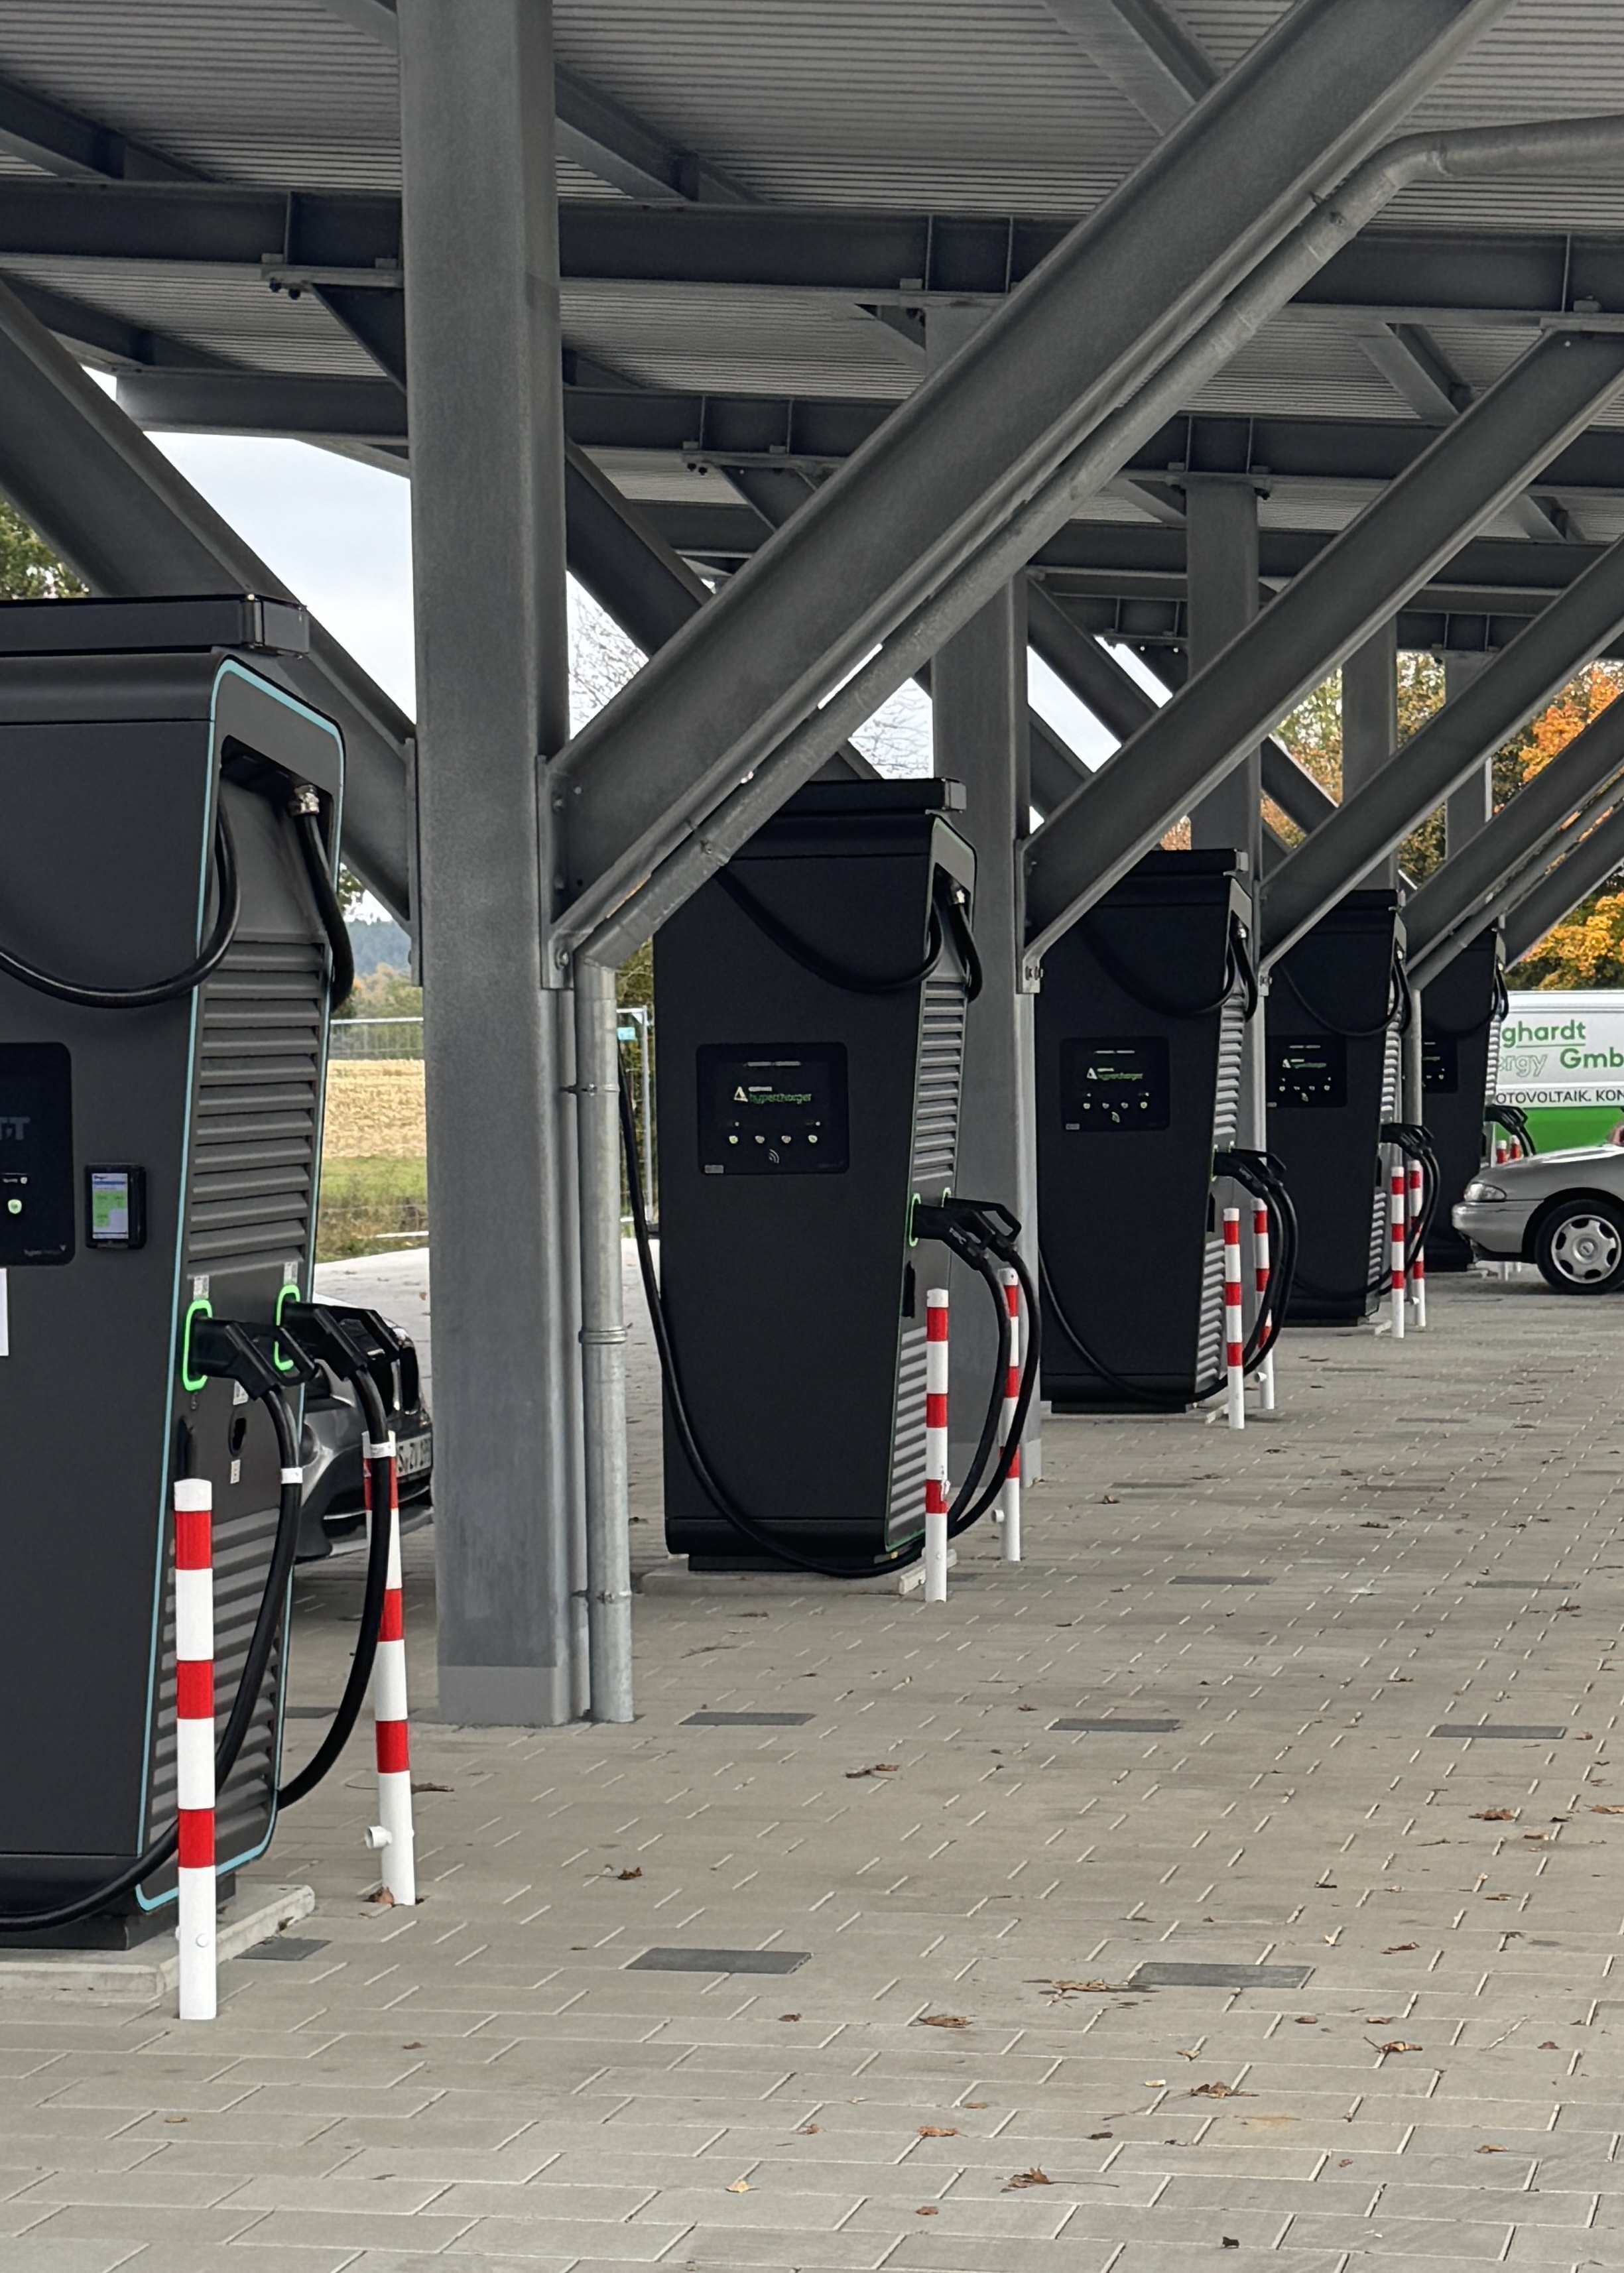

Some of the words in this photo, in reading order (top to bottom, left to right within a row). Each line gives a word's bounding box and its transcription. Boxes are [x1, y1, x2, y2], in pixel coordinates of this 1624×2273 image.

[1501, 1019, 1586, 1048] ghardt
[1560, 1047, 1624, 1069] Gmb
[1496, 1090, 1592, 1104] OTOVOLTAIK.
